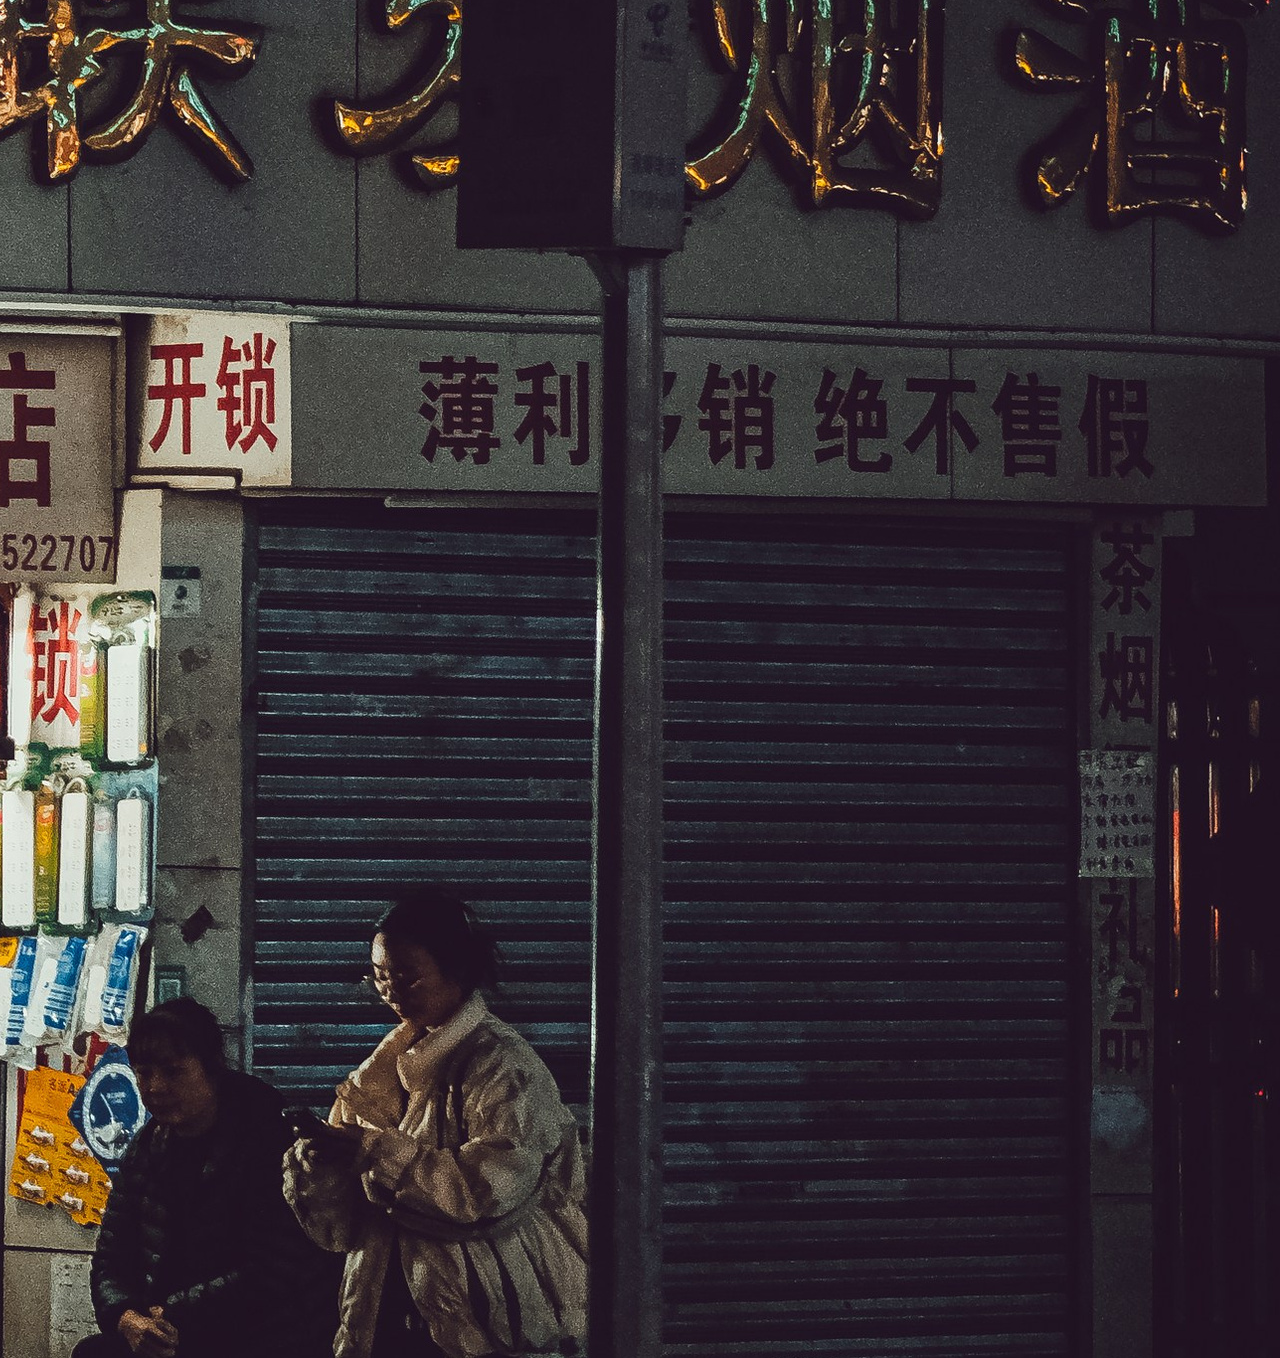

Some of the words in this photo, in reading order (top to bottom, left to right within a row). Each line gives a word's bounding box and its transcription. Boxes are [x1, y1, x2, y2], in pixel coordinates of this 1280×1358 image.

[148, 332, 278, 454] 开锁
[418, 355, 775, 471] 薄利销
[813, 367, 1155, 481] 绝不售假
[28, 600, 81, 727] 锁
[1099, 522, 1155, 1073] 茶烟礼品
